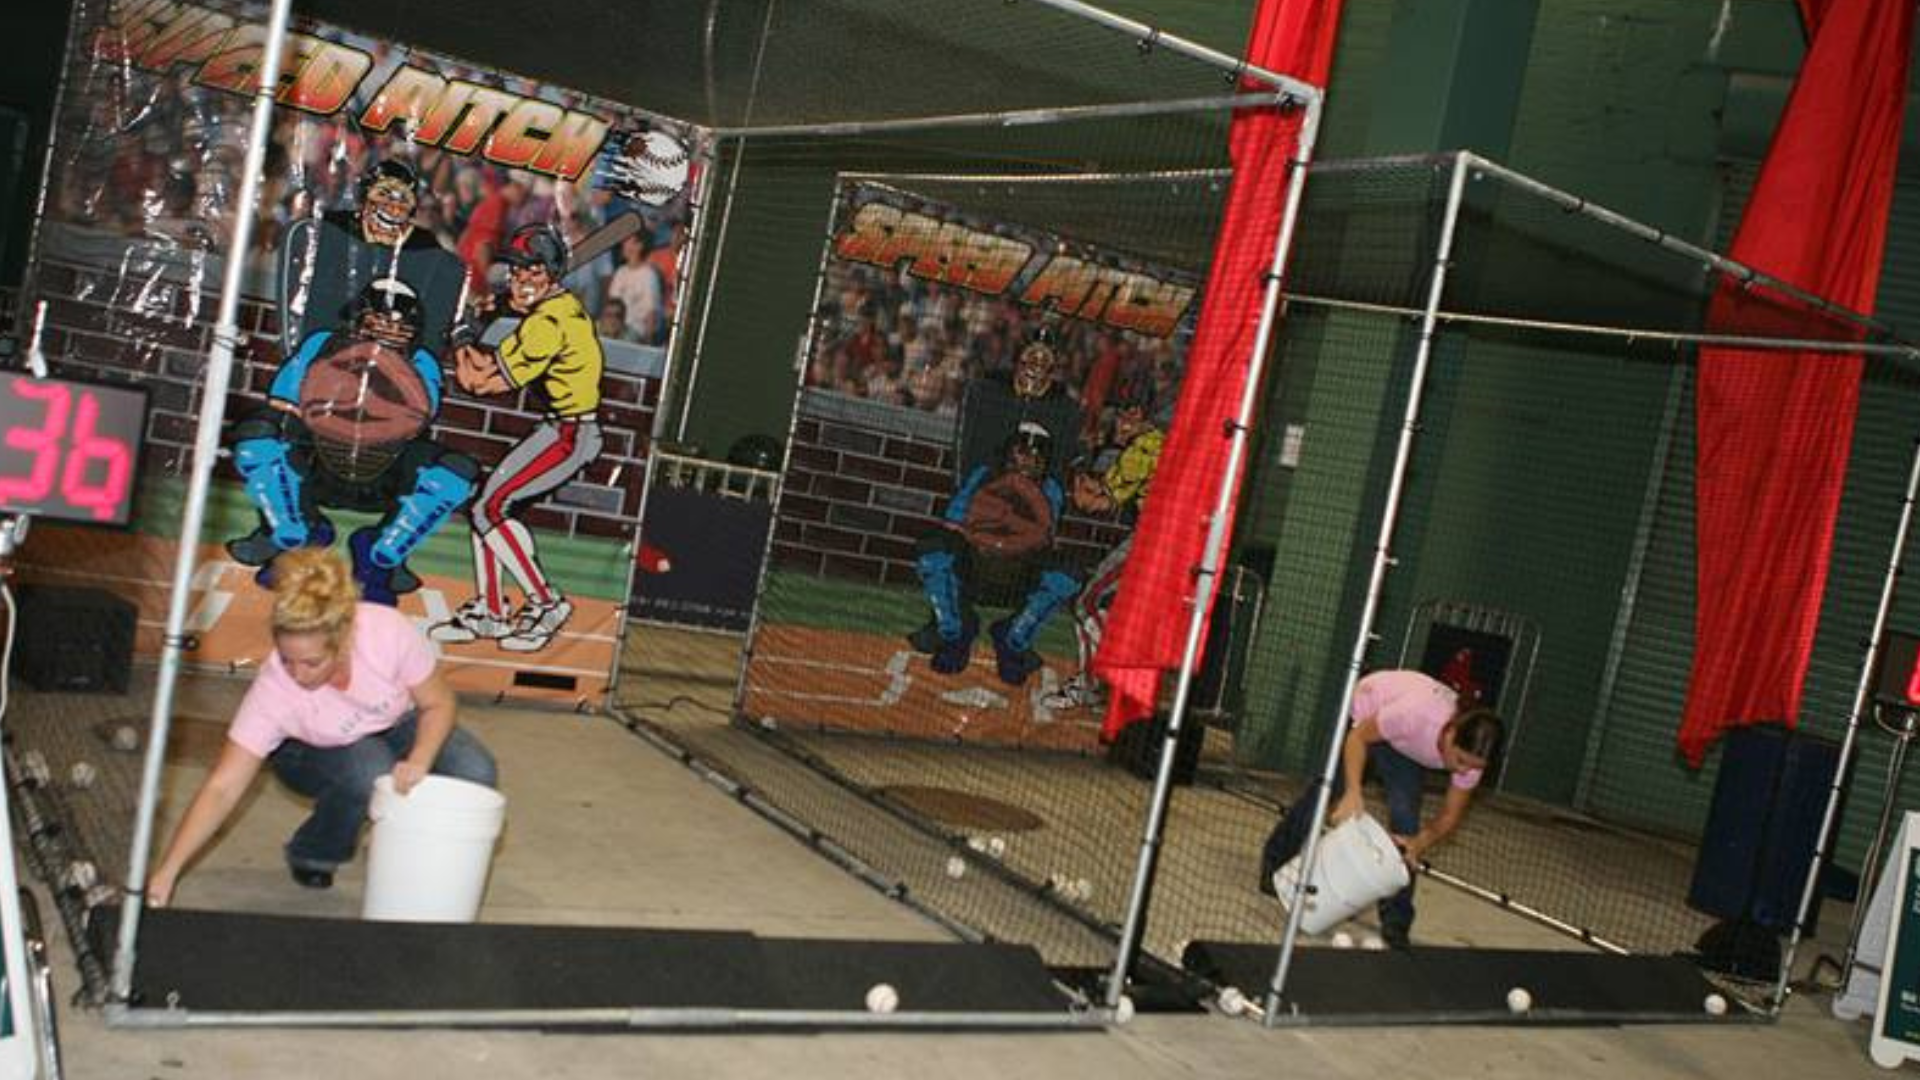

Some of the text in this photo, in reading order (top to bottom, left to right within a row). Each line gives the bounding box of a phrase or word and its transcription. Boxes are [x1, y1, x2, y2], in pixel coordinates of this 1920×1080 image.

[360, 64, 612, 182] PITCH
[835, 202, 1198, 340] SPEED PITCH
[0, 377, 130, 520] 36
